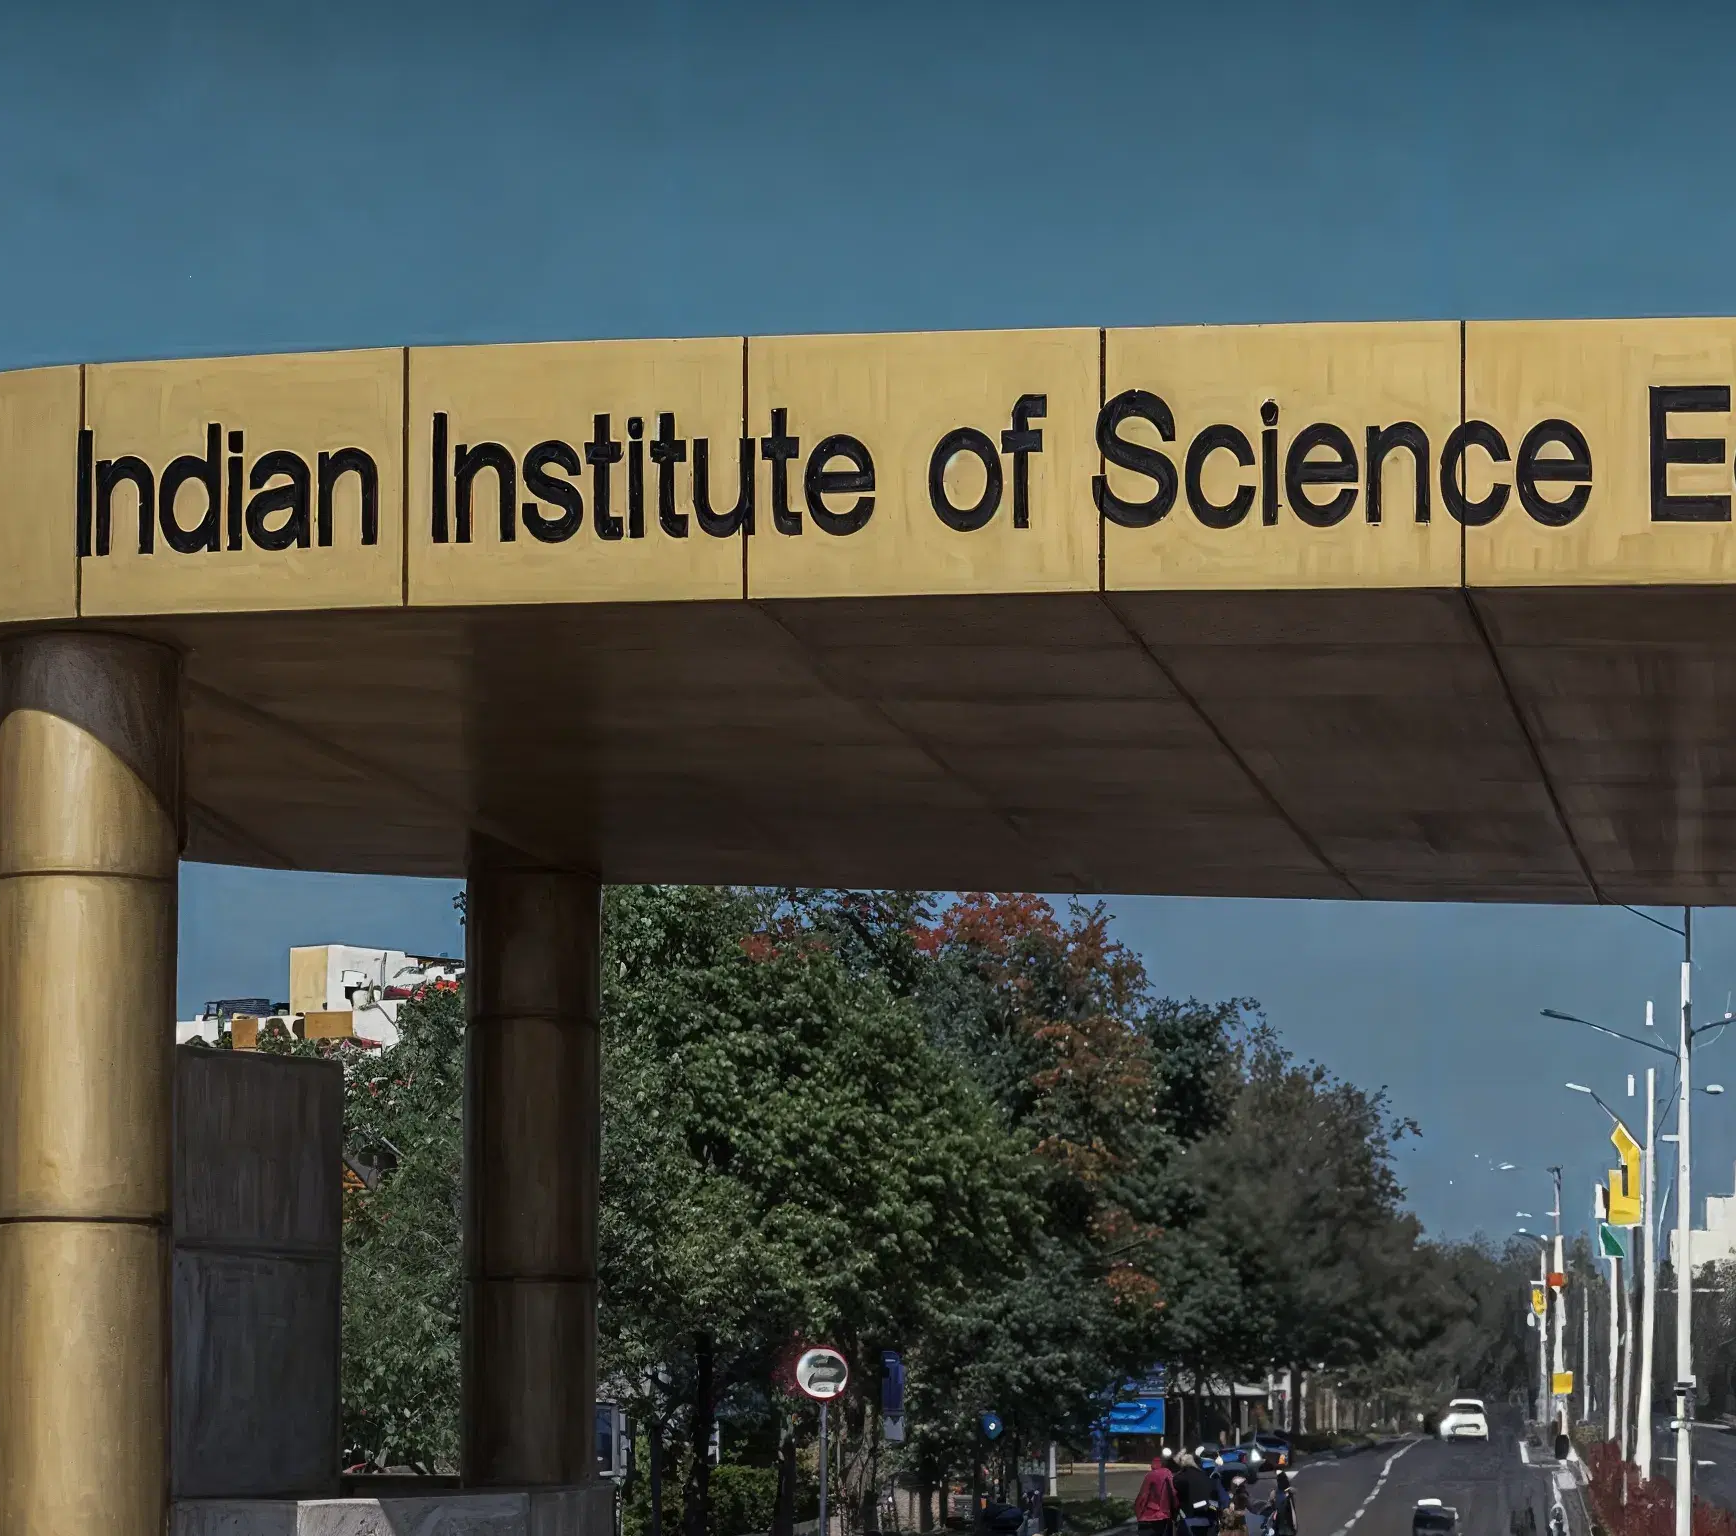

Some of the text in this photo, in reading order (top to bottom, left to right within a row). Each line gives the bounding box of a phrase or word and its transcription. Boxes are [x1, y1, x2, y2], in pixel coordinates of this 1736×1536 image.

[77, 422, 379, 558] Indian
[431, 407, 876, 544] Institute
[928, 393, 1048, 533] of
[1095, 390, 1593, 530] Science
